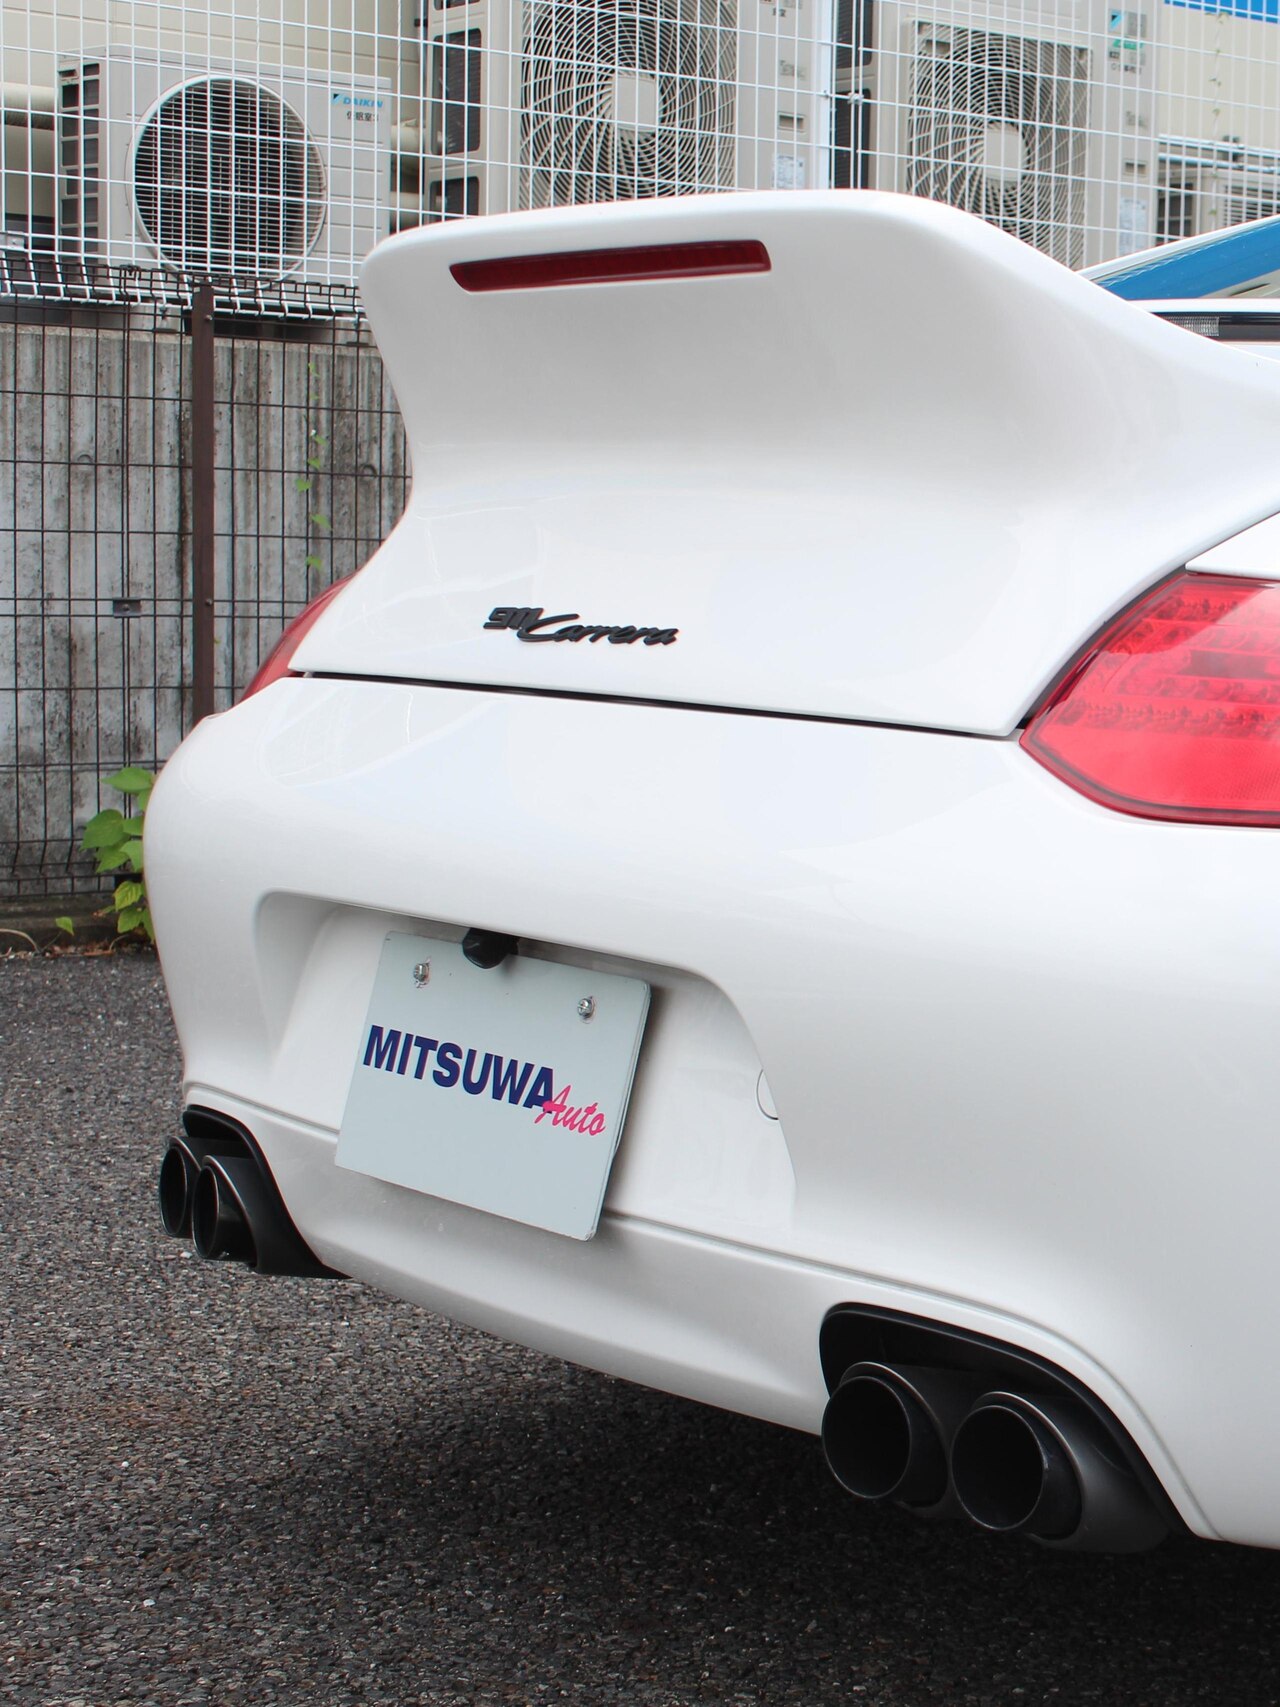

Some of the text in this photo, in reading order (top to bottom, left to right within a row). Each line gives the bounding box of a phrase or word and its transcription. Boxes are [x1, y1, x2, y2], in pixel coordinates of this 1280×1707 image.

[516, 613, 679, 646] Carrera
[363, 1024, 606, 1136] MITSUWA Auto
